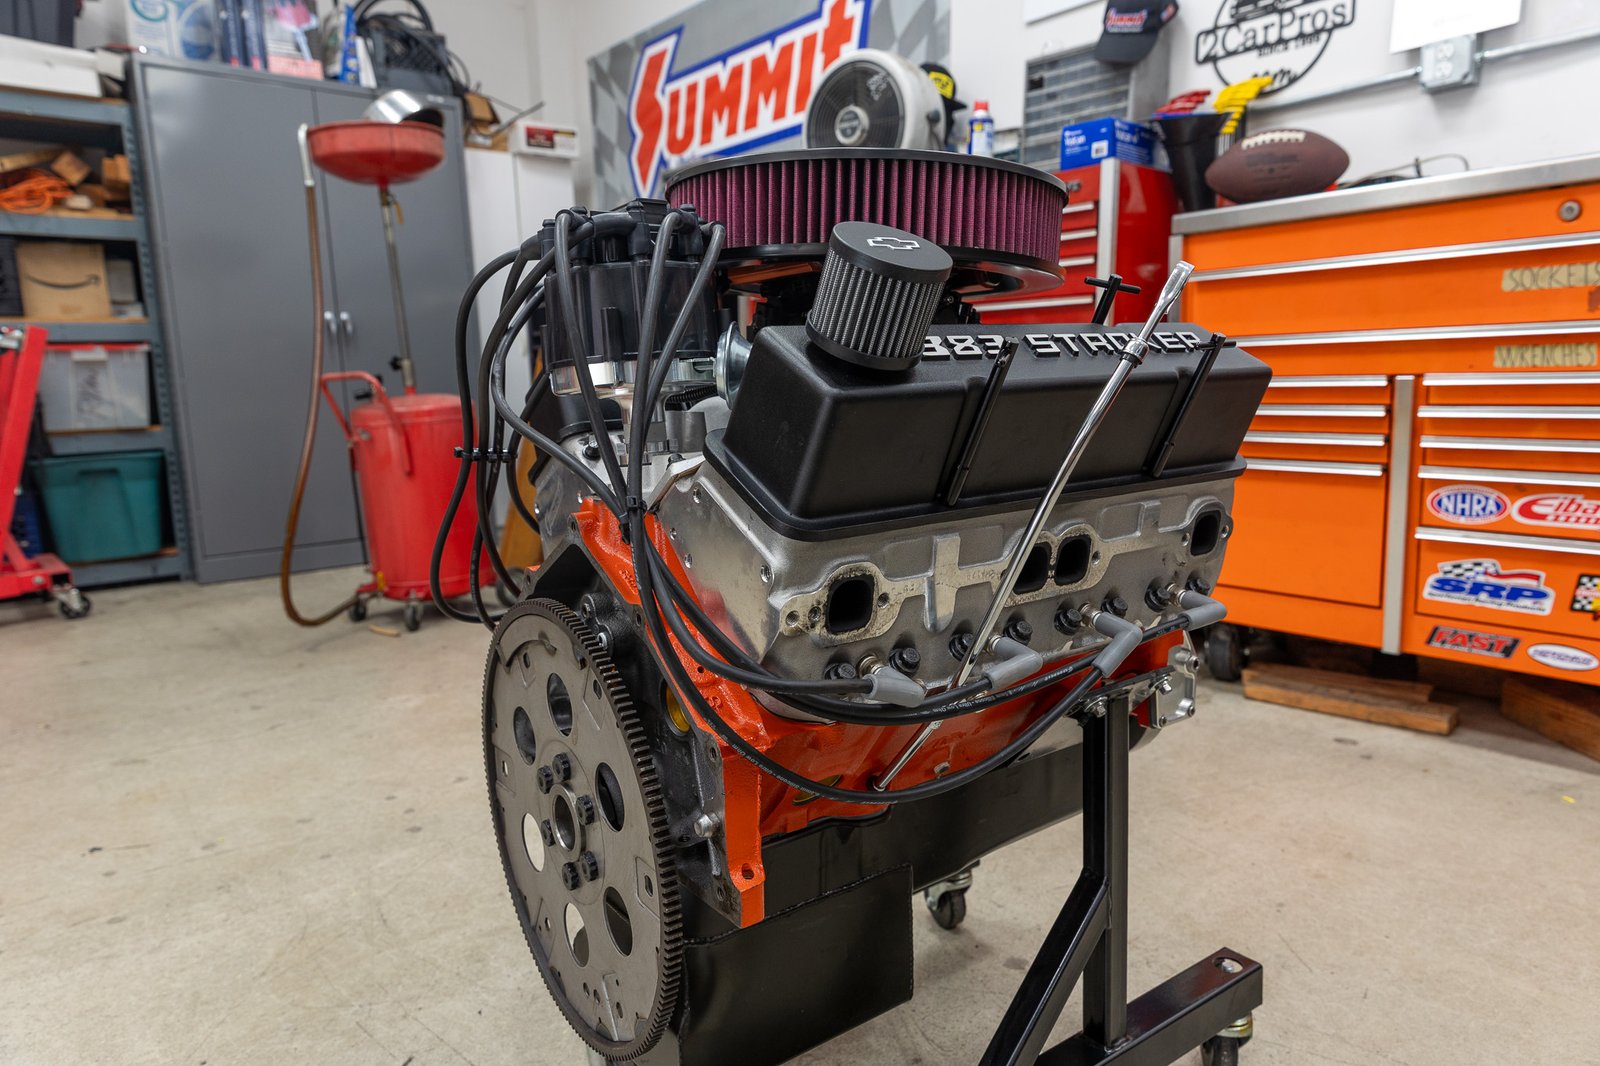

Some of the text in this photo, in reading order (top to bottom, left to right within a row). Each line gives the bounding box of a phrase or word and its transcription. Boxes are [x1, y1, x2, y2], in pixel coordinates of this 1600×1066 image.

[1439, 491, 1498, 518] NHRA
[1429, 578, 1549, 601] SRP
[1433, 630, 1509, 653] FAST
